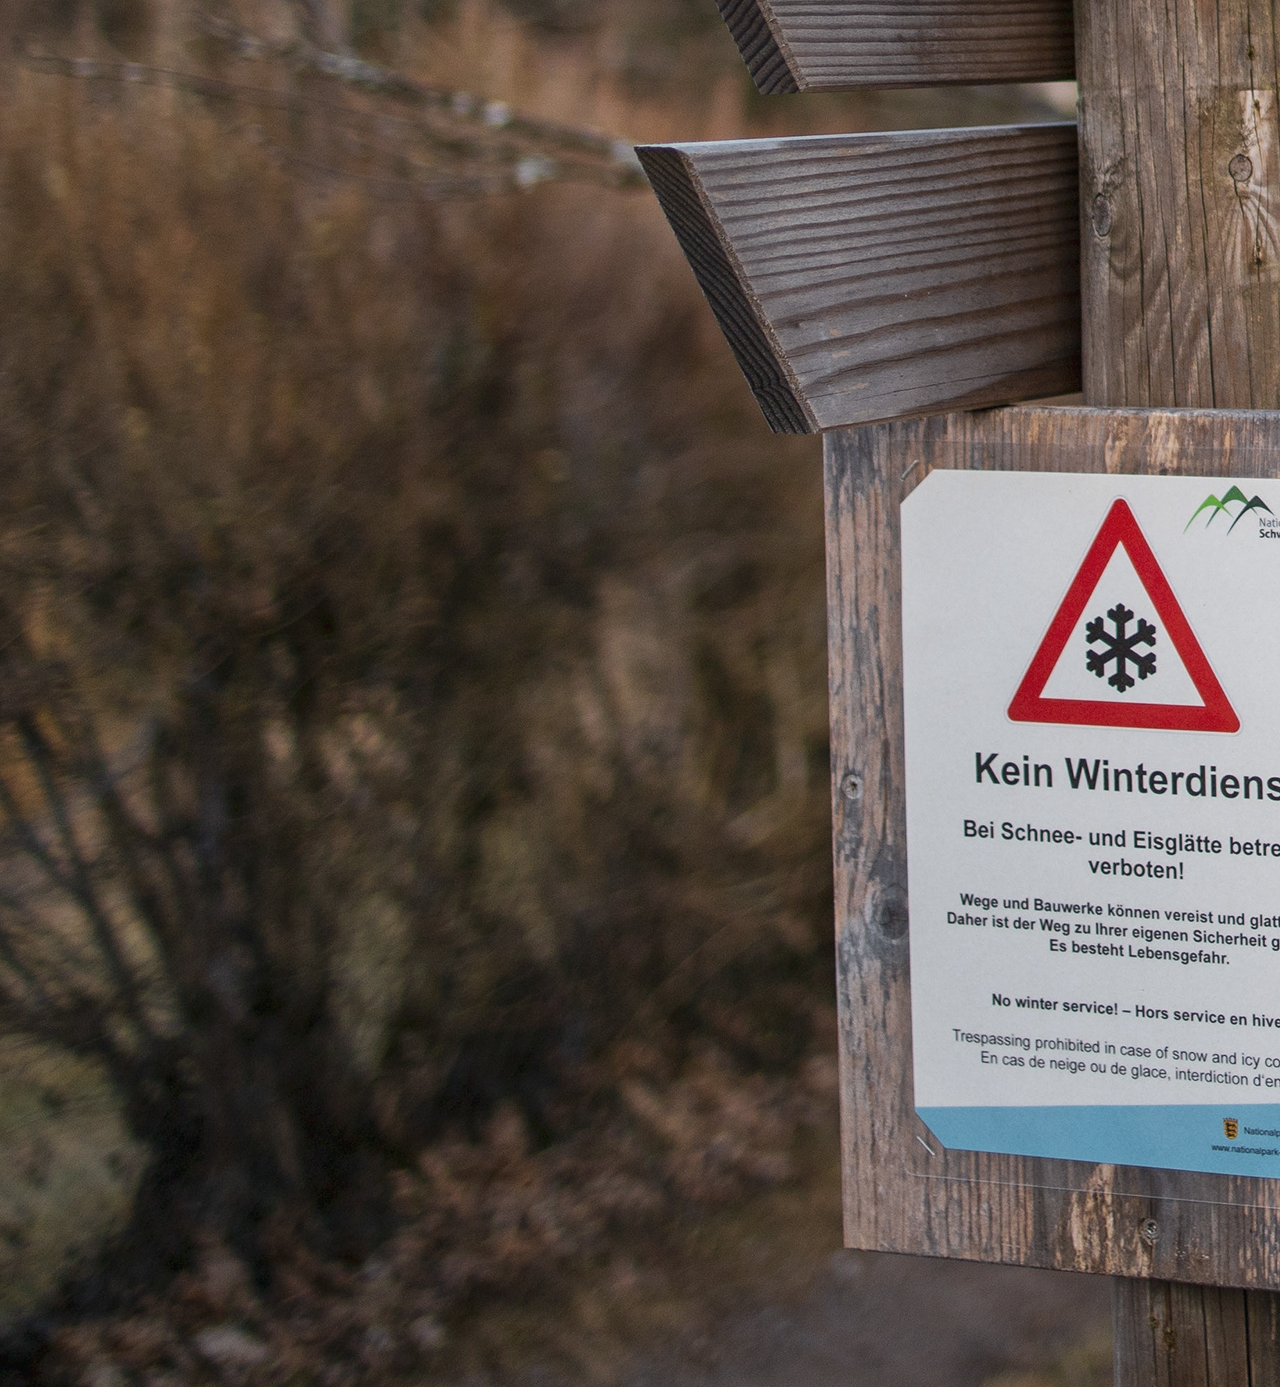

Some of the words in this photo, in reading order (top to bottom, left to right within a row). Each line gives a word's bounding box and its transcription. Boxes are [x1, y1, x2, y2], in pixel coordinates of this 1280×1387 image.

[975, 752, 1053, 788] Kein
[963, 819, 994, 839] Bei
[1001, 822, 1083, 844] Schnee-
[1089, 829, 1126, 848] und
[1133, 830, 1222, 856] Eisglätte
[1088, 858, 1184, 880] verboten!
[959, 893, 999, 911] Wege
[1003, 897, 1029, 910] und
[1034, 898, 1103, 916] Bauwerke
[1107, 903, 1160, 920] können
[1164, 909, 1214, 924] vereist
[1217, 913, 1245, 926] und
[947, 911, 988, 927] Daher
[992, 915, 1010, 929] ist
[1013, 916, 1036, 930] der
[1039, 918, 1070, 936] Weg
[1074, 924, 1091, 934] zu
[1095, 922, 1128, 937] Ihrer
[1132, 925, 1188, 943] eigenen
[1193, 929, 1267, 948] Sicherheit
[1049, 938, 1067, 953] Es
[1071, 940, 1125, 957] besteht
[1128, 944, 1230, 965] Lebensgefahr.
[992, 993, 1011, 1007] No
[1015, 996, 1059, 1011] winter
[1062, 1001, 1118, 1015] service!
[1135, 1004, 1169, 1020] Hors
[1173, 1010, 1226, 1024] service
[1230, 1015, 1247, 1026] en
[952, 1028, 1031, 1051] Trespassing
[1035, 1037, 1100, 1053] prohibited
[1104, 1041, 1116, 1055] in
[1120, 1045, 1152, 1058] case
[1155, 1046, 1169, 1059] of
[1172, 1050, 1208, 1062] snow
[1212, 1052, 1237, 1065] and
[1241, 1052, 1261, 1070] icy
[981, 1050, 998, 1064] En
[1002, 1055, 1025, 1067] cas
[1028, 1055, 1045, 1069] de
[1050, 1057, 1086, 1074] neige
[1090, 1062, 1106, 1074] ou
[1110, 1062, 1127, 1076] de
[1131, 1064, 1171, 1081] glace,
[1175, 1067, 1249, 1086] interdiction
